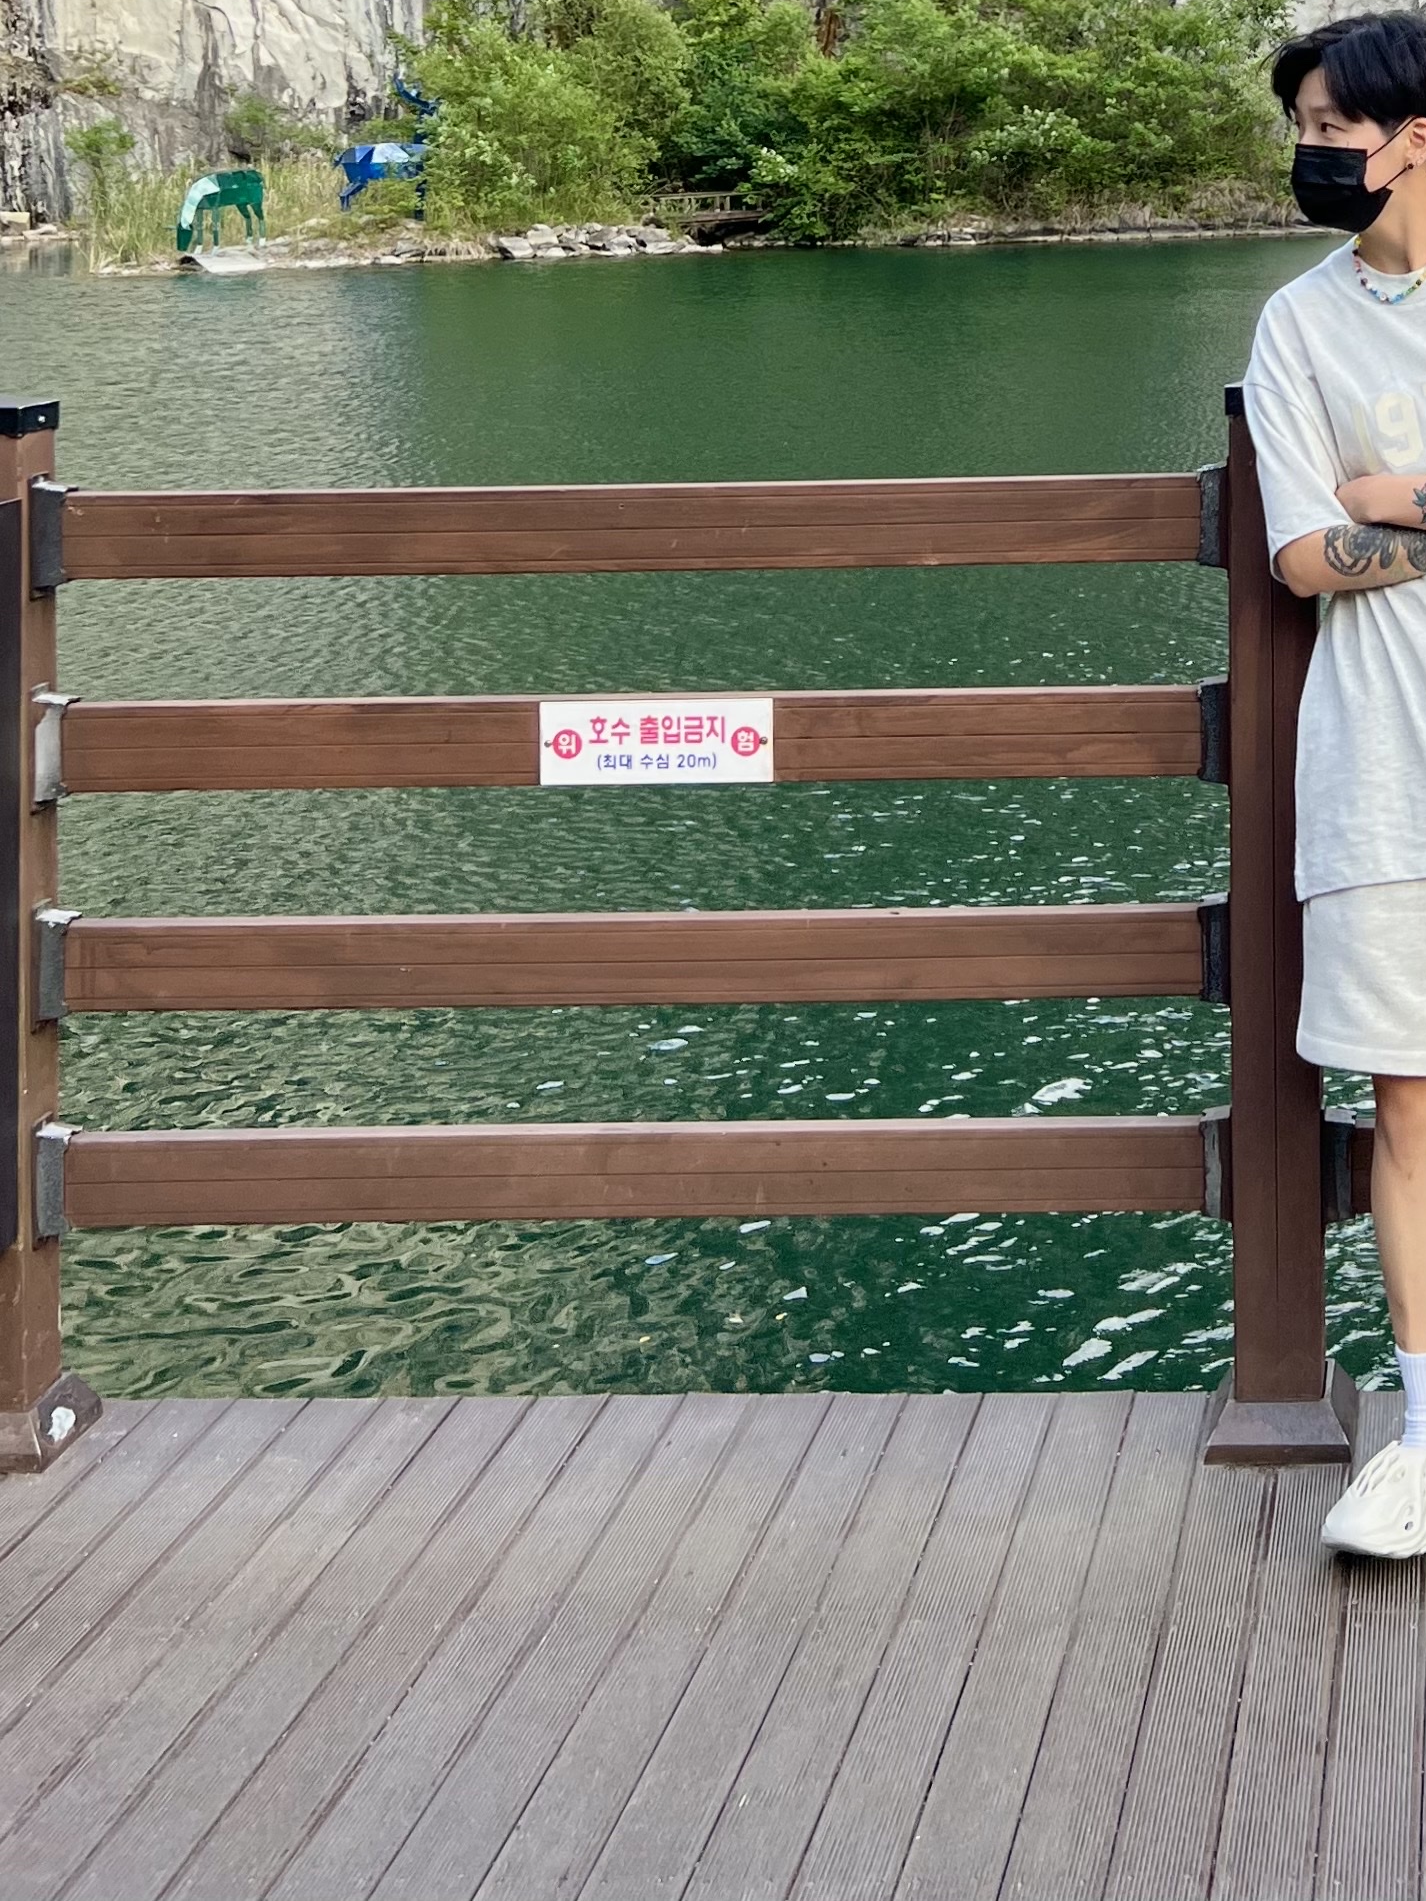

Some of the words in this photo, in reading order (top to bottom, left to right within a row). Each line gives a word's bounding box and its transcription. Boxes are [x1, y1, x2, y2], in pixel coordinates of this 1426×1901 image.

[588, 716, 631, 745] 호수
[639, 715, 726, 744] 출입금지
[557, 733, 577, 755] 위
[736, 731, 755, 752] 험
[597, 753, 633, 770] (최대
[640, 753, 670, 769] 수심
[677, 752, 717, 770] 20m)
